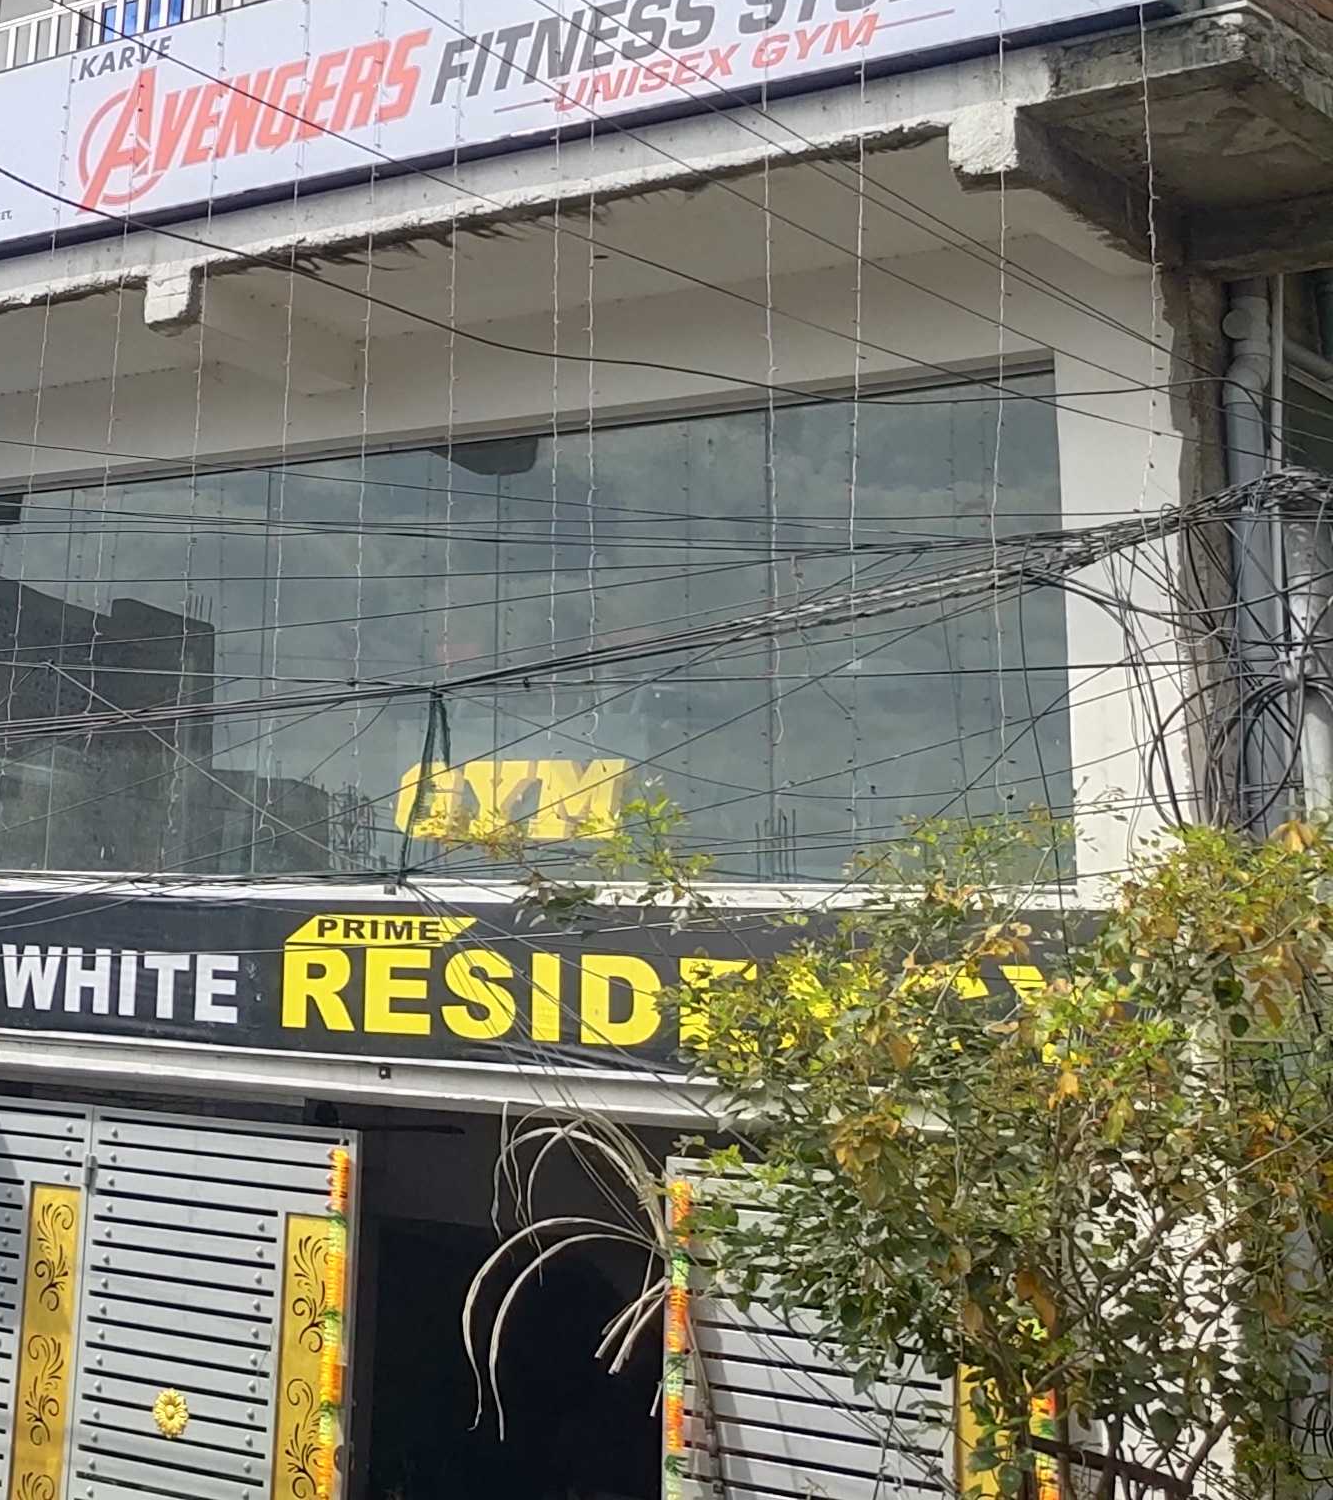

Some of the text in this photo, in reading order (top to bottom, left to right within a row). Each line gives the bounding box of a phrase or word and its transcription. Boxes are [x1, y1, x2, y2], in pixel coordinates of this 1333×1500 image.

[78, 35, 172, 81] KARVE
[553, 11, 880, 113] UNISEX GYM
[76, 28, 432, 215] AVENGERS
[395, 758, 625, 839] GYM
[316, 917, 442, 942] PRIME
[282, 948, 1113, 1068] RESIDE
